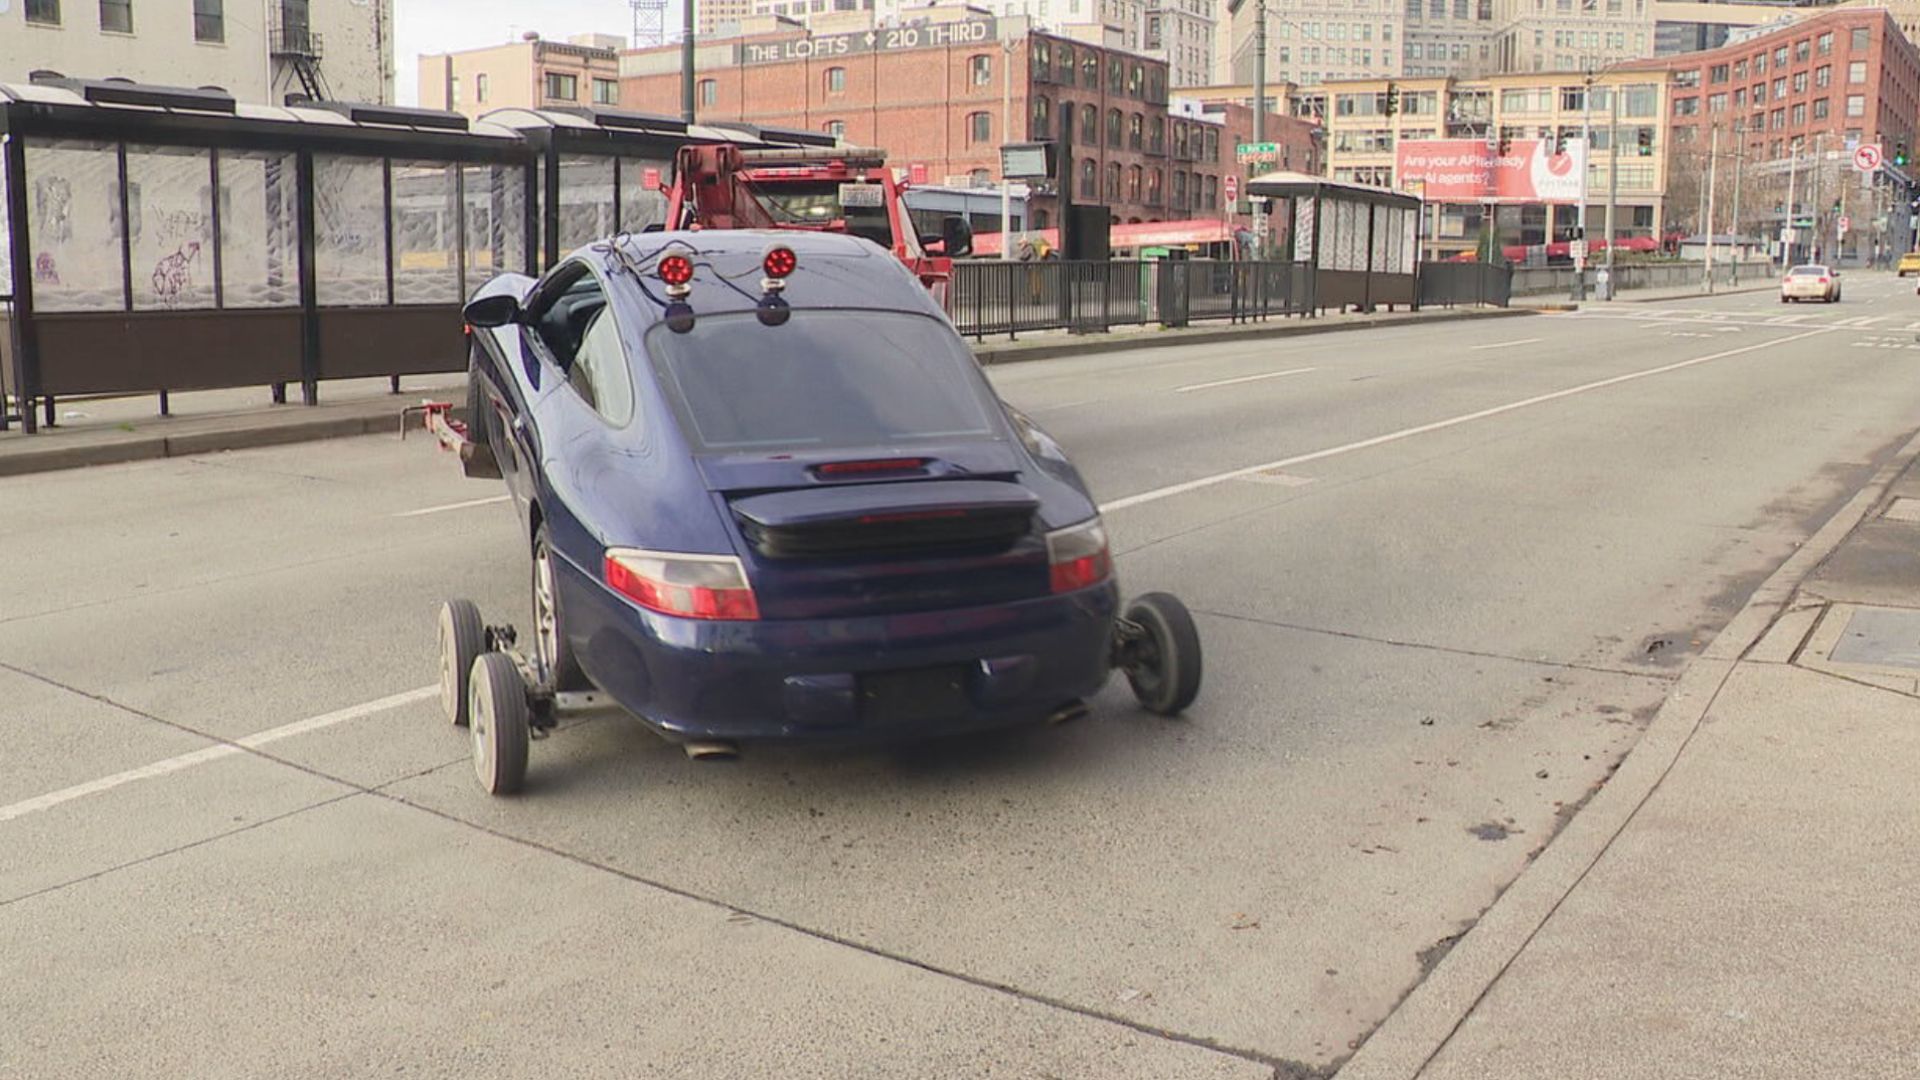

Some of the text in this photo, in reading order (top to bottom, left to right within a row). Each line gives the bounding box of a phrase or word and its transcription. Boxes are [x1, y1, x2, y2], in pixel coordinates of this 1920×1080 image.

[749, 23, 986, 61] THE LOFTS 210 THIRD
[1403, 156, 1425, 167] Are
[1427, 157, 1456, 170] your
